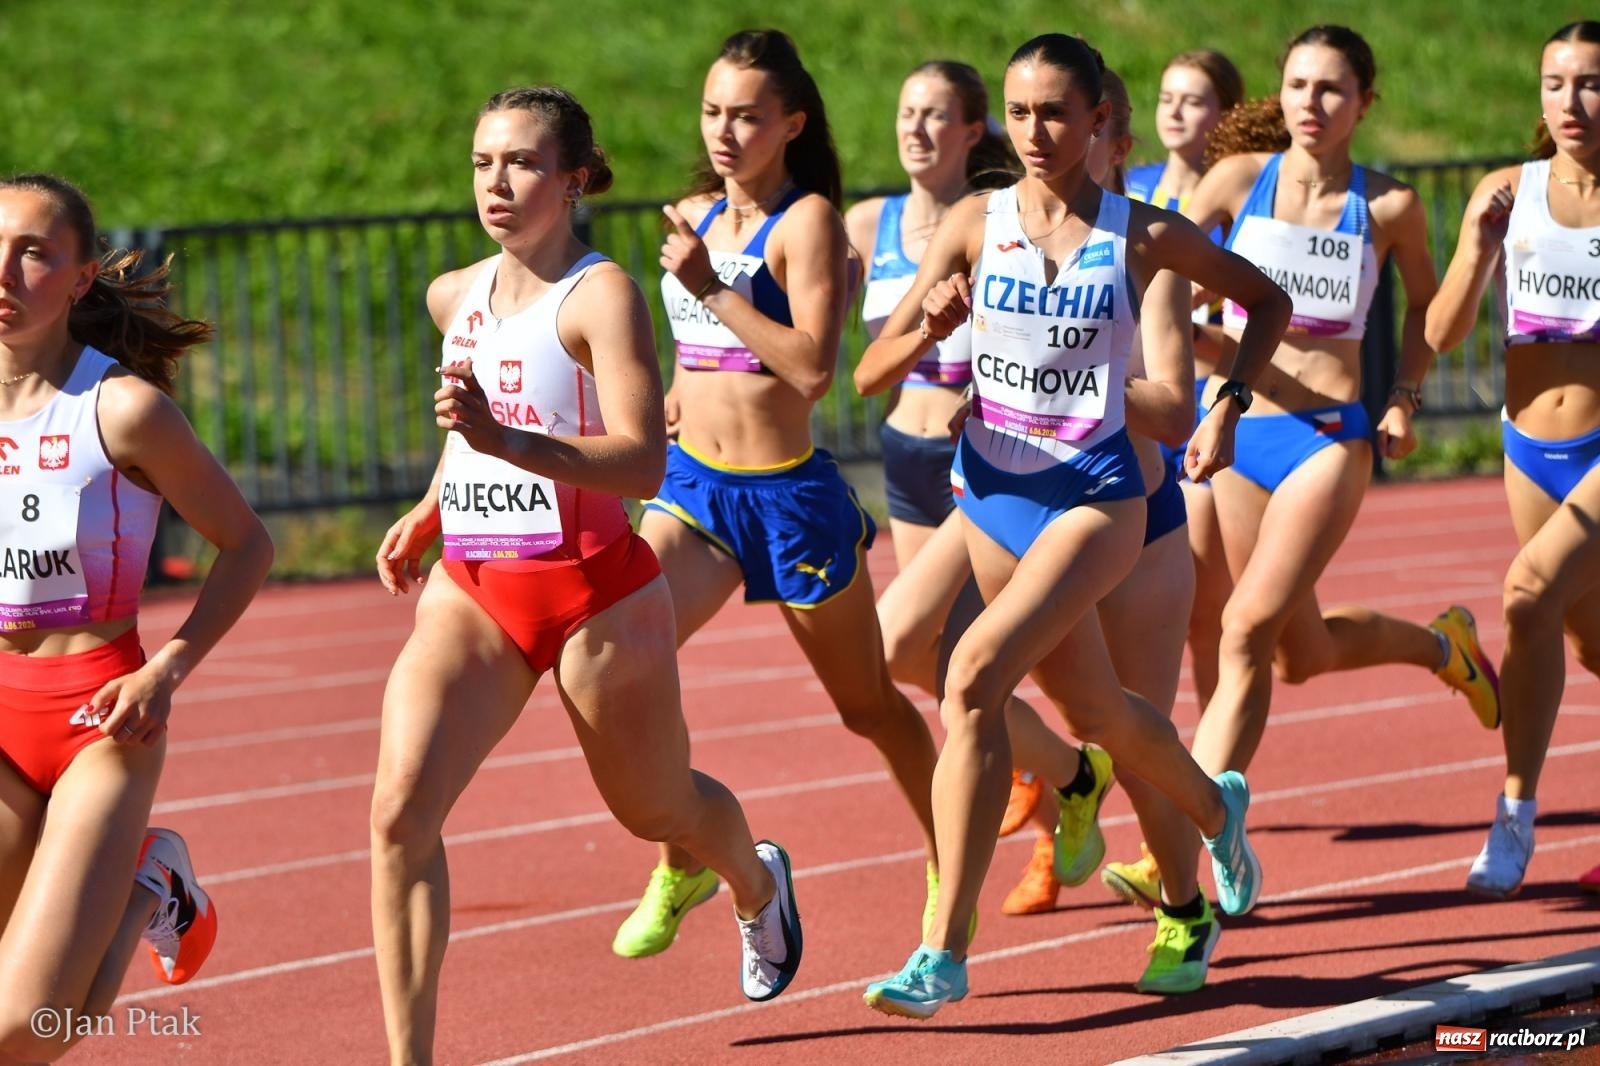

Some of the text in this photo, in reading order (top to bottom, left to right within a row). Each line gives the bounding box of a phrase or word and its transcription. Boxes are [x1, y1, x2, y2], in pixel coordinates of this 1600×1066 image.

[1307, 235, 1350, 261] 108
[983, 274, 1114, 320] CZECHIA
[451, 335, 478, 349] ORLEN
[1047, 325, 1099, 350] 107
[977, 353, 1099, 397] CECHOVÁ
[21, 493, 40, 522] 8
[441, 482, 552, 518] PAJĘCKA
[0, 547, 76, 580] ARUK
